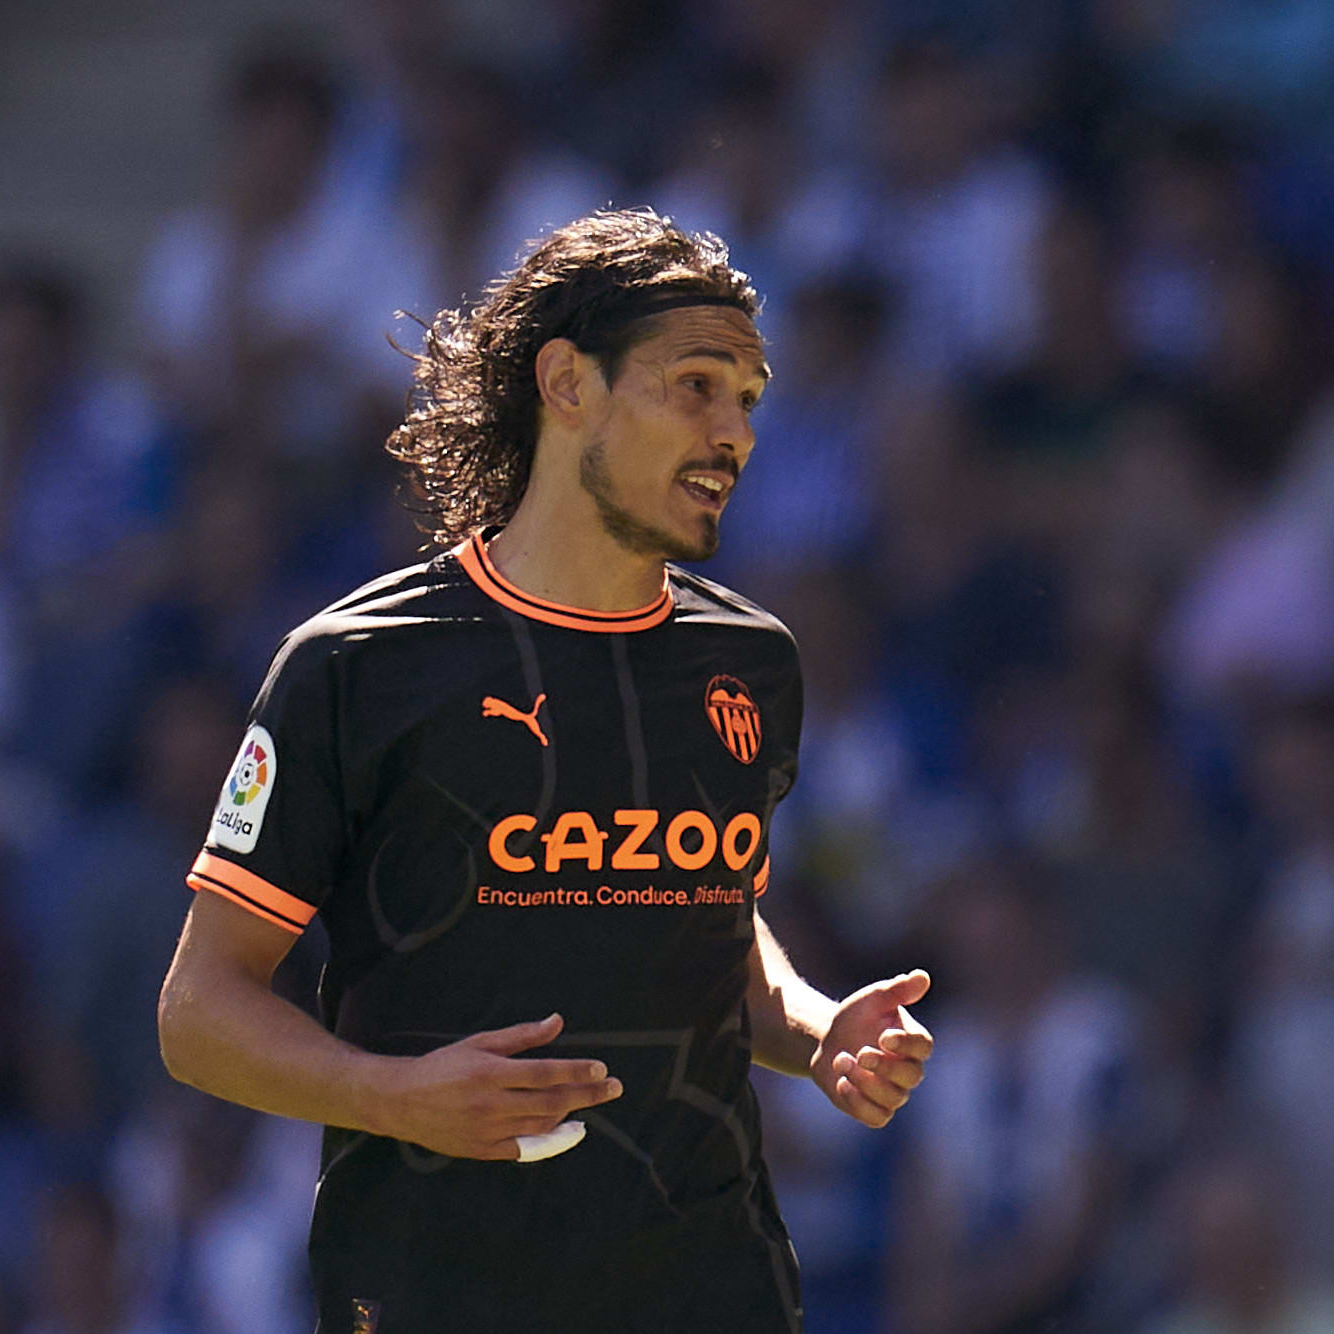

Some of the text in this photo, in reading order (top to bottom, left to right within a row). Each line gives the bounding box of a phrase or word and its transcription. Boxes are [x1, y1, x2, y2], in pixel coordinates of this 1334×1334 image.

[488, 809, 761, 873] CAZOO
[477, 885, 593, 906] Encuentra.
[596, 885, 691, 905] Conduce.
